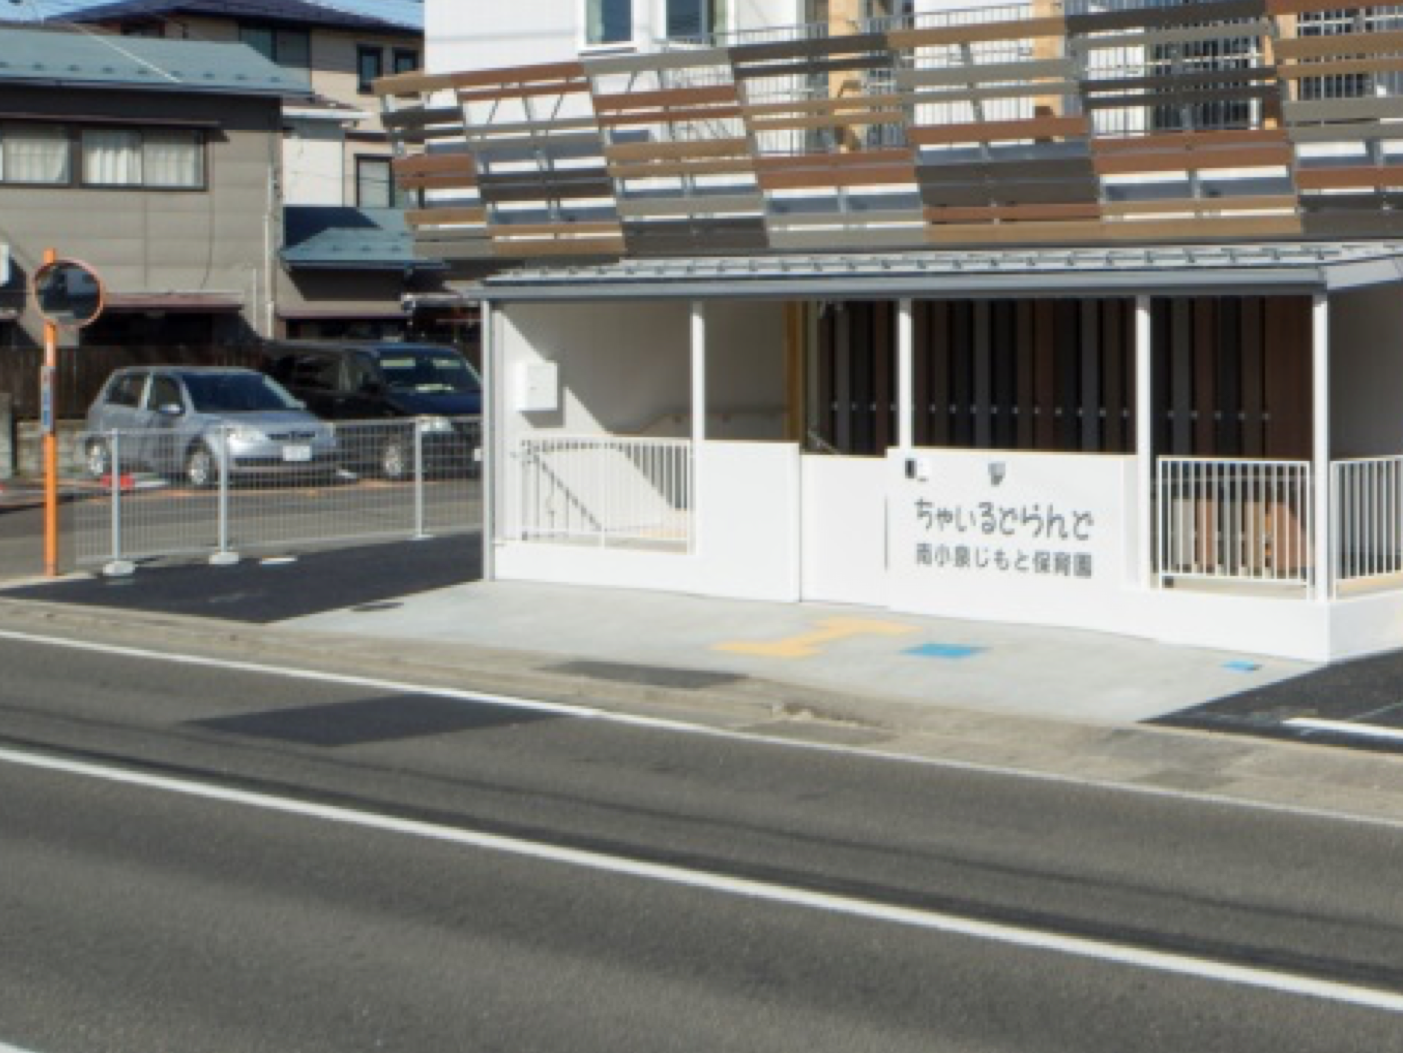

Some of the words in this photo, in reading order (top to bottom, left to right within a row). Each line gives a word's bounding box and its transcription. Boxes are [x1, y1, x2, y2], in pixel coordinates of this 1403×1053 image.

[914, 497, 1094, 541] ちゃいるどらんど
[916, 543, 1092, 579] 南小泉じもと保育園
